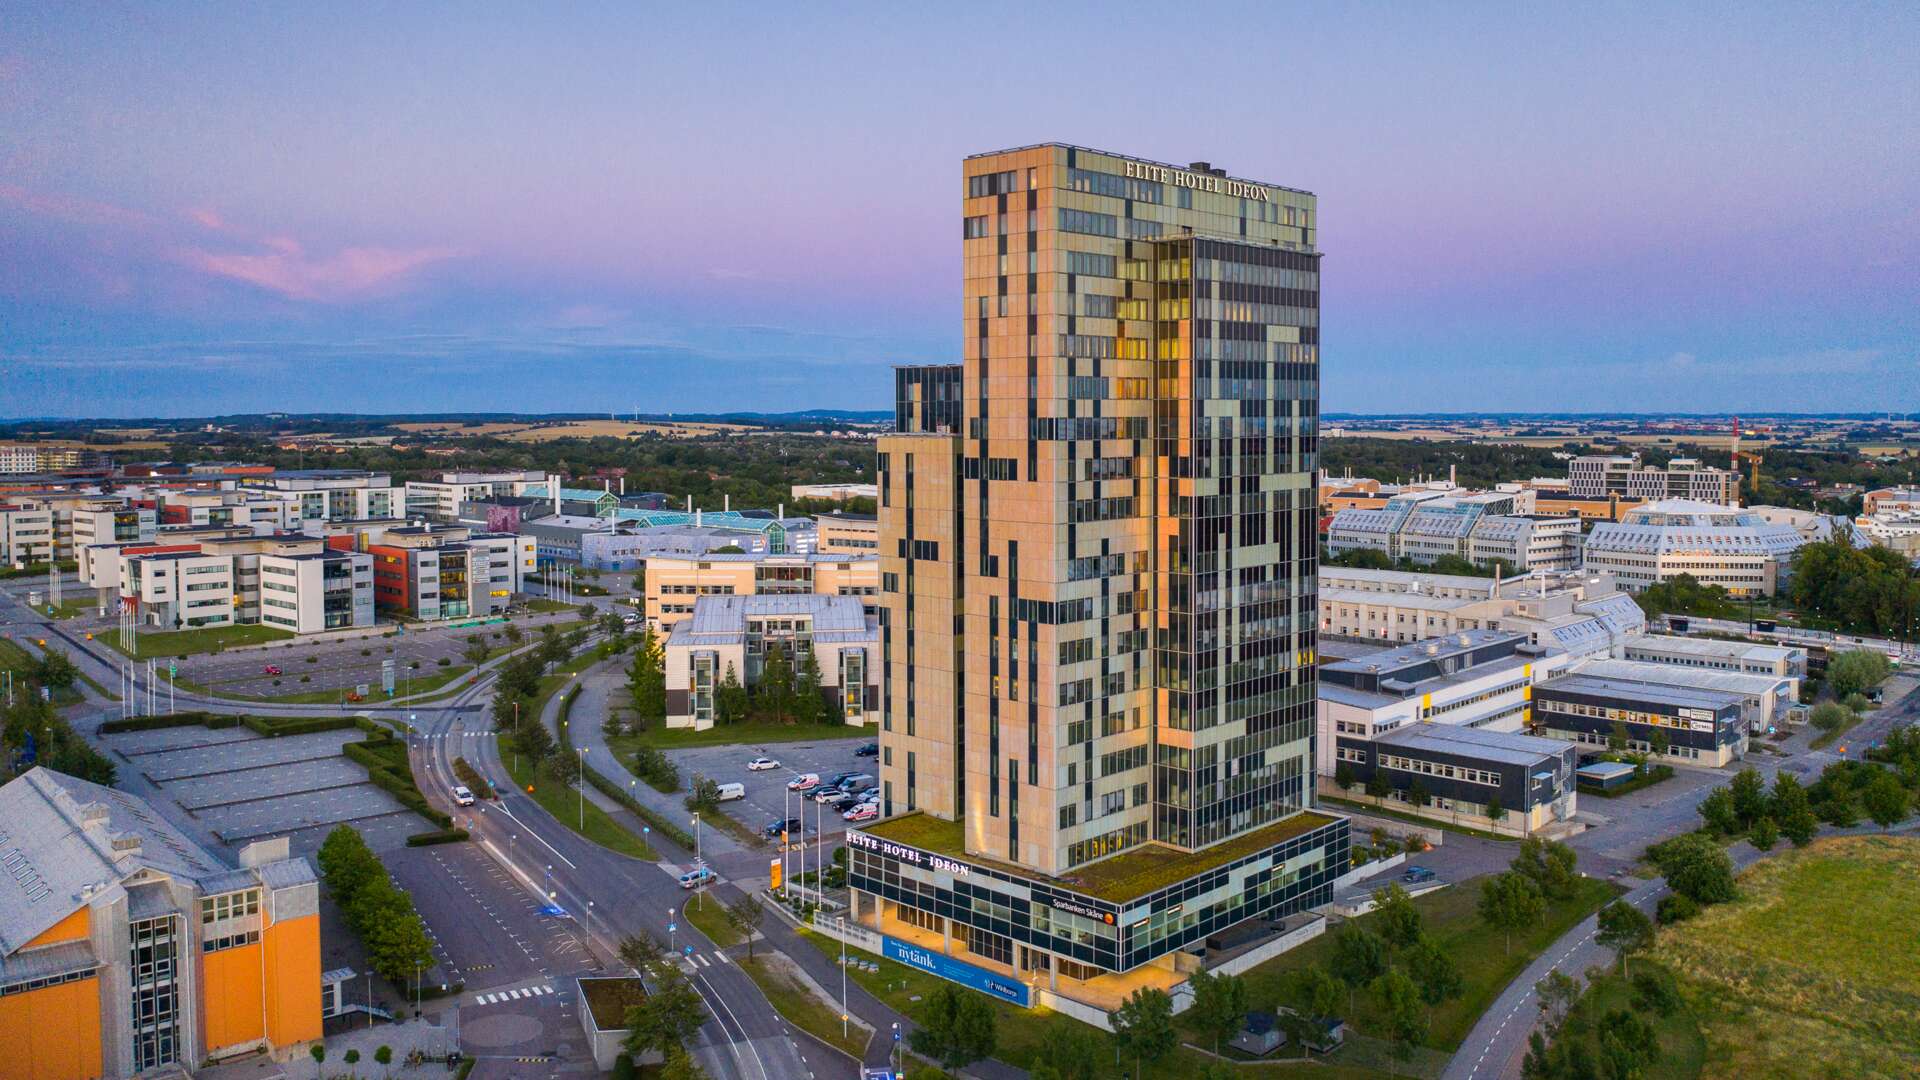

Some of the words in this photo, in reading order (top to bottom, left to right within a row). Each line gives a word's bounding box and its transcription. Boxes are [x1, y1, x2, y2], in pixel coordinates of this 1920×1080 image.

[1126, 161, 1168, 183] ELITE
[1175, 171, 1221, 193] HOTEL
[1226, 181, 1269, 202] IDEON
[846, 832, 878, 850] ELITE
[883, 843, 922, 863] HOTEL
[929, 855, 969, 877] IDEON
[1053, 899, 1086, 914] Sparbanken
[1086, 908, 1104, 920] Skåne
